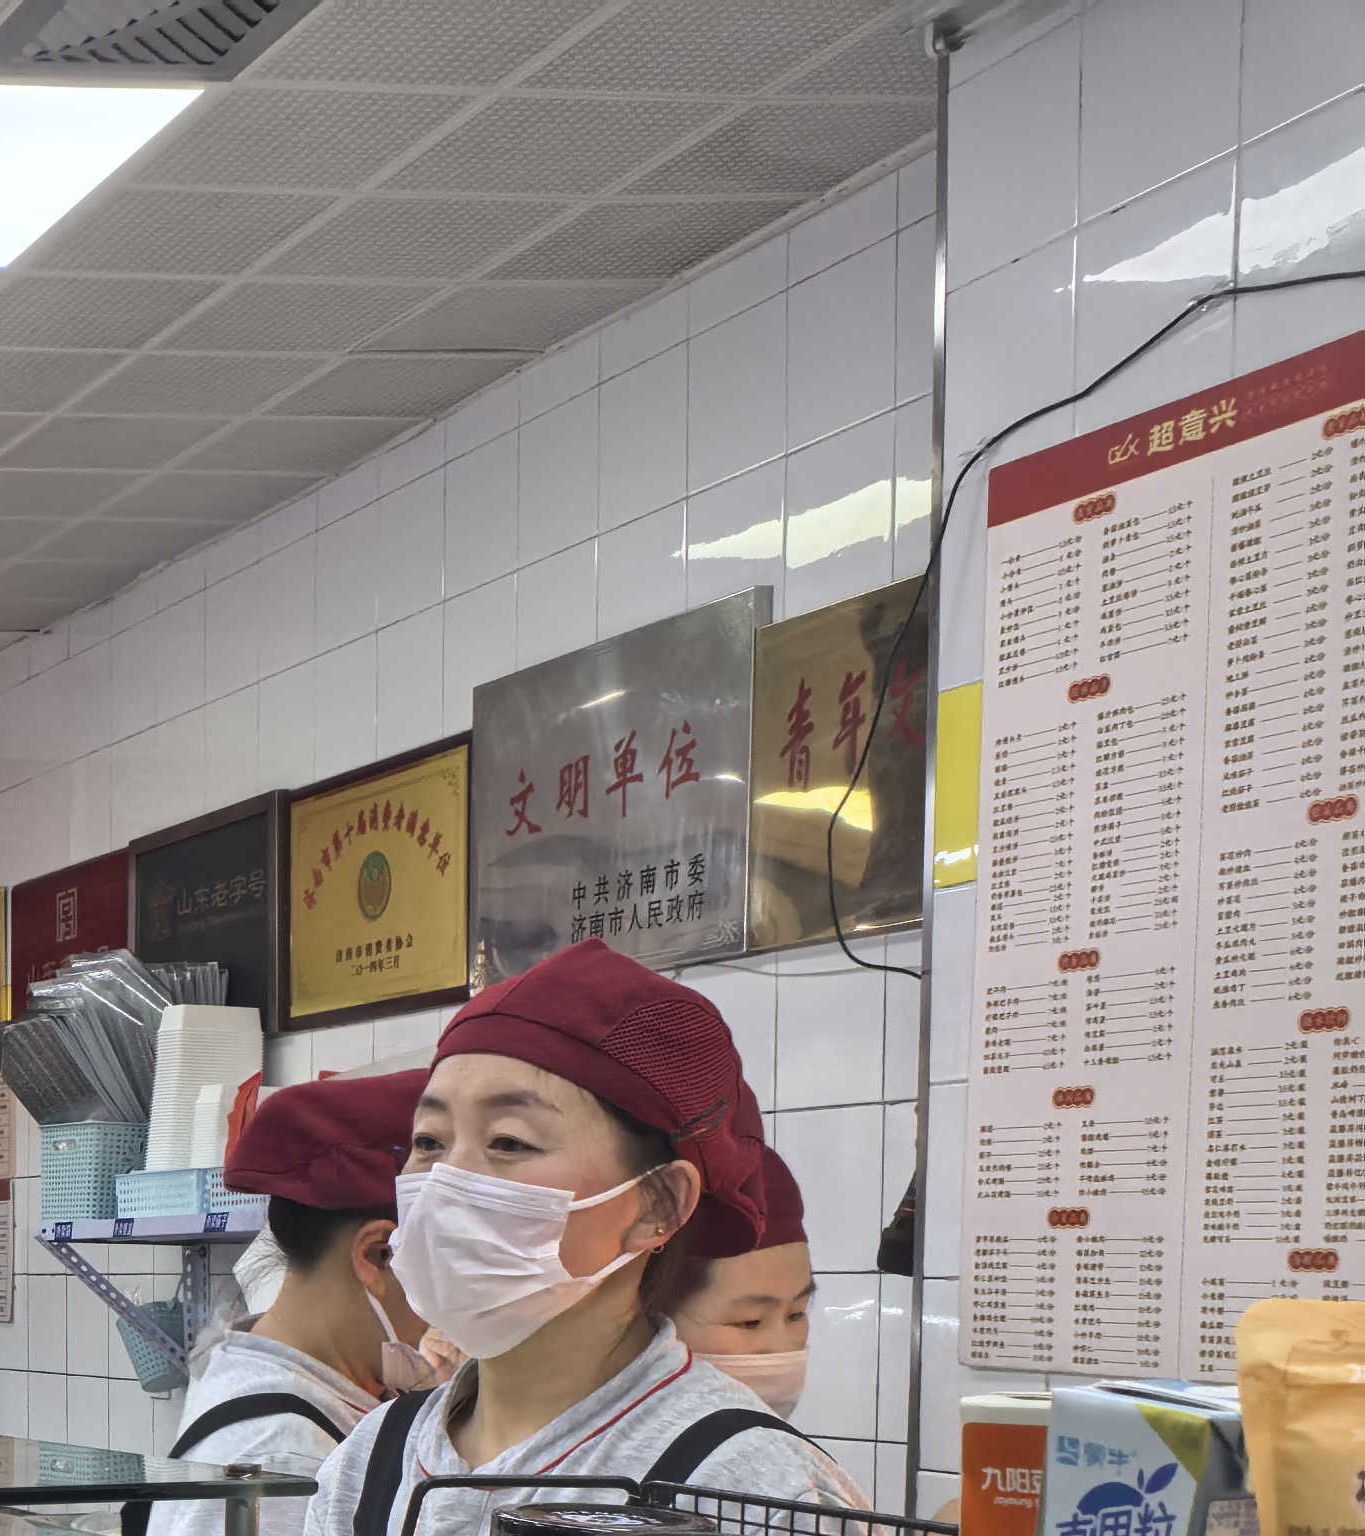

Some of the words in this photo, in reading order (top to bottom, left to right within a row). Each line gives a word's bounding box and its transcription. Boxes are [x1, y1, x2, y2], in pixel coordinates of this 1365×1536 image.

[1147, 398, 1238, 456] 超意兴
[506, 720, 701, 837] 文明单位
[177, 869, 266, 915] 山东老字号
[571, 852, 706, 908] 中共济南市委
[571, 889, 706, 943] 济南市人民政府
